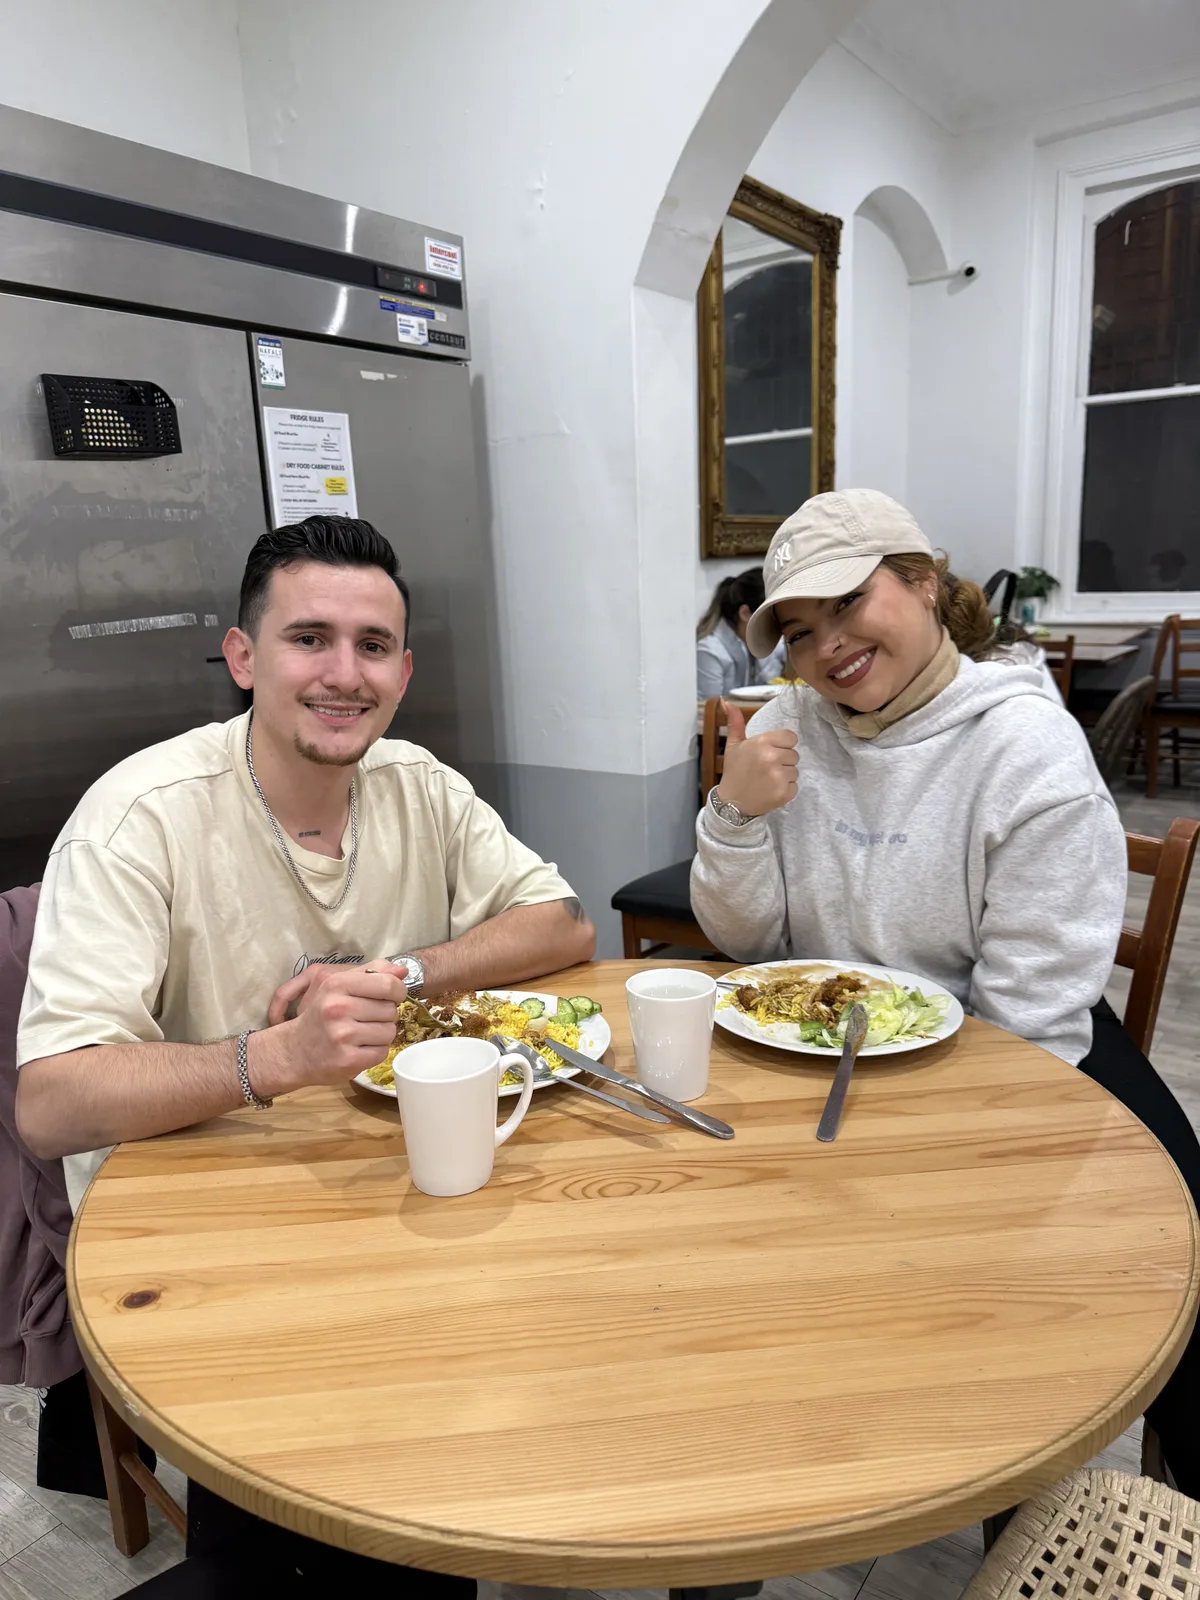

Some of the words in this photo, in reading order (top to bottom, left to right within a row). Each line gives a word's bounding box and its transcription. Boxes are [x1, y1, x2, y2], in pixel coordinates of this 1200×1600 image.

[429, 331, 465, 346] centaur
[290, 414, 308, 422] FRIDGE
[309, 415, 324, 423] RULES
